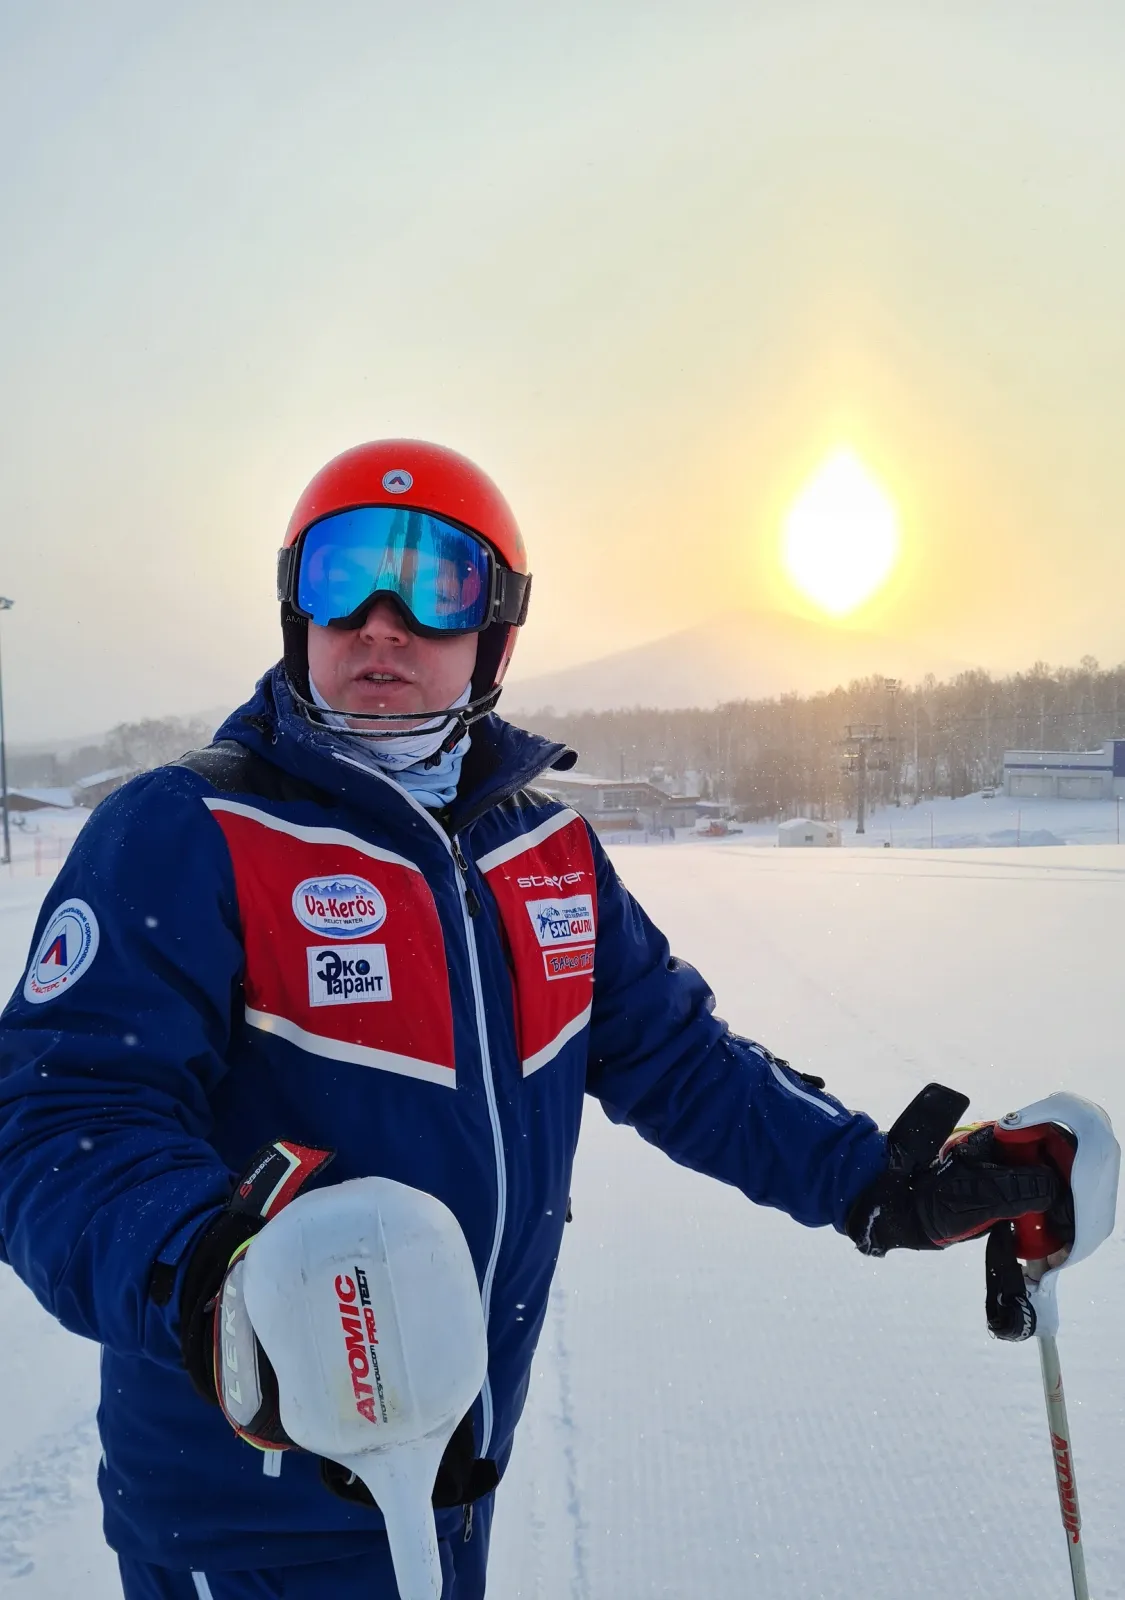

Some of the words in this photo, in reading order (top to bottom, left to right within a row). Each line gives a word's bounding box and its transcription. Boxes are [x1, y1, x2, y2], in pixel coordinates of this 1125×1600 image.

[517, 871, 585, 891] stayer
[304, 895, 376, 918] Va-Kerös
[324, 917, 342, 925] RELICT
[343, 917, 363, 925] WATER
[225, 1284, 243, 1405] LEKI
[334, 1274, 378, 1424] ATOMIC
